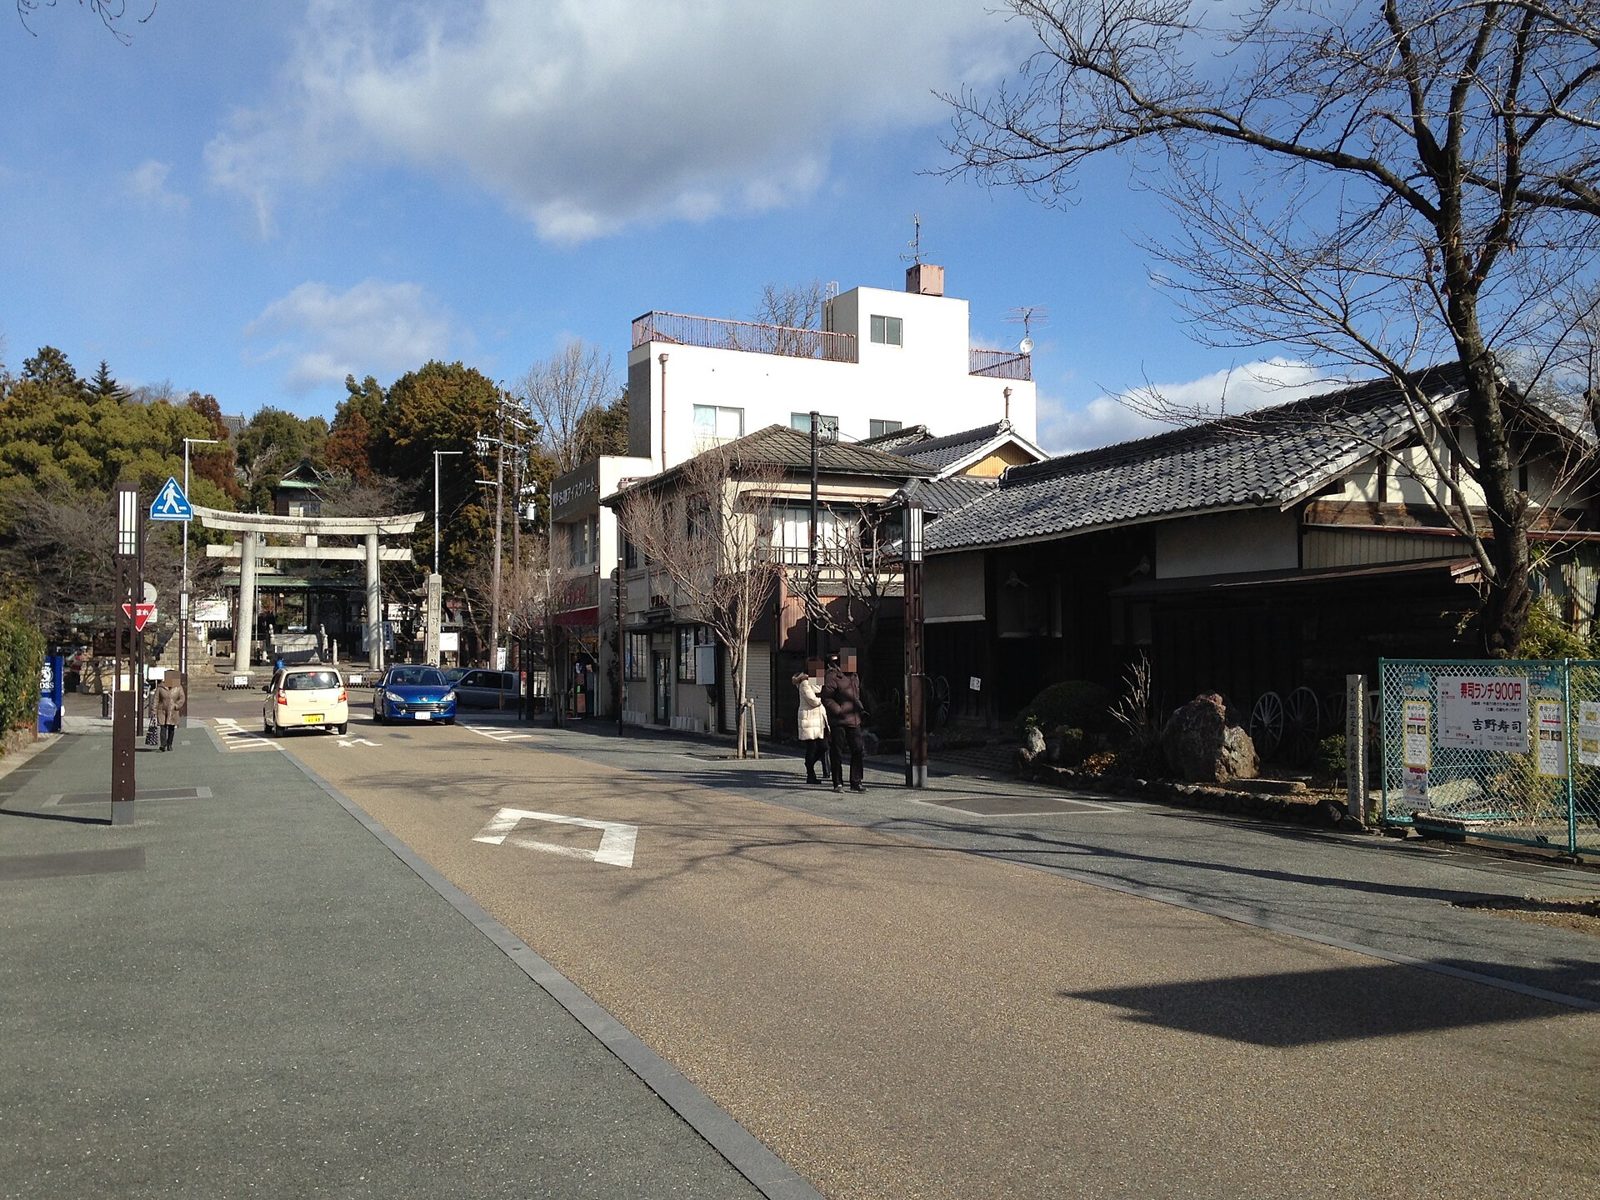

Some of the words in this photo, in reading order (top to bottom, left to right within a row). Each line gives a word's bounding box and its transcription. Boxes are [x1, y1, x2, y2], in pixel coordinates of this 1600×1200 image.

[1460, 682, 1521, 700] 寿司ランチ900円
[1472, 718, 1522, 733] 吉野寿司
